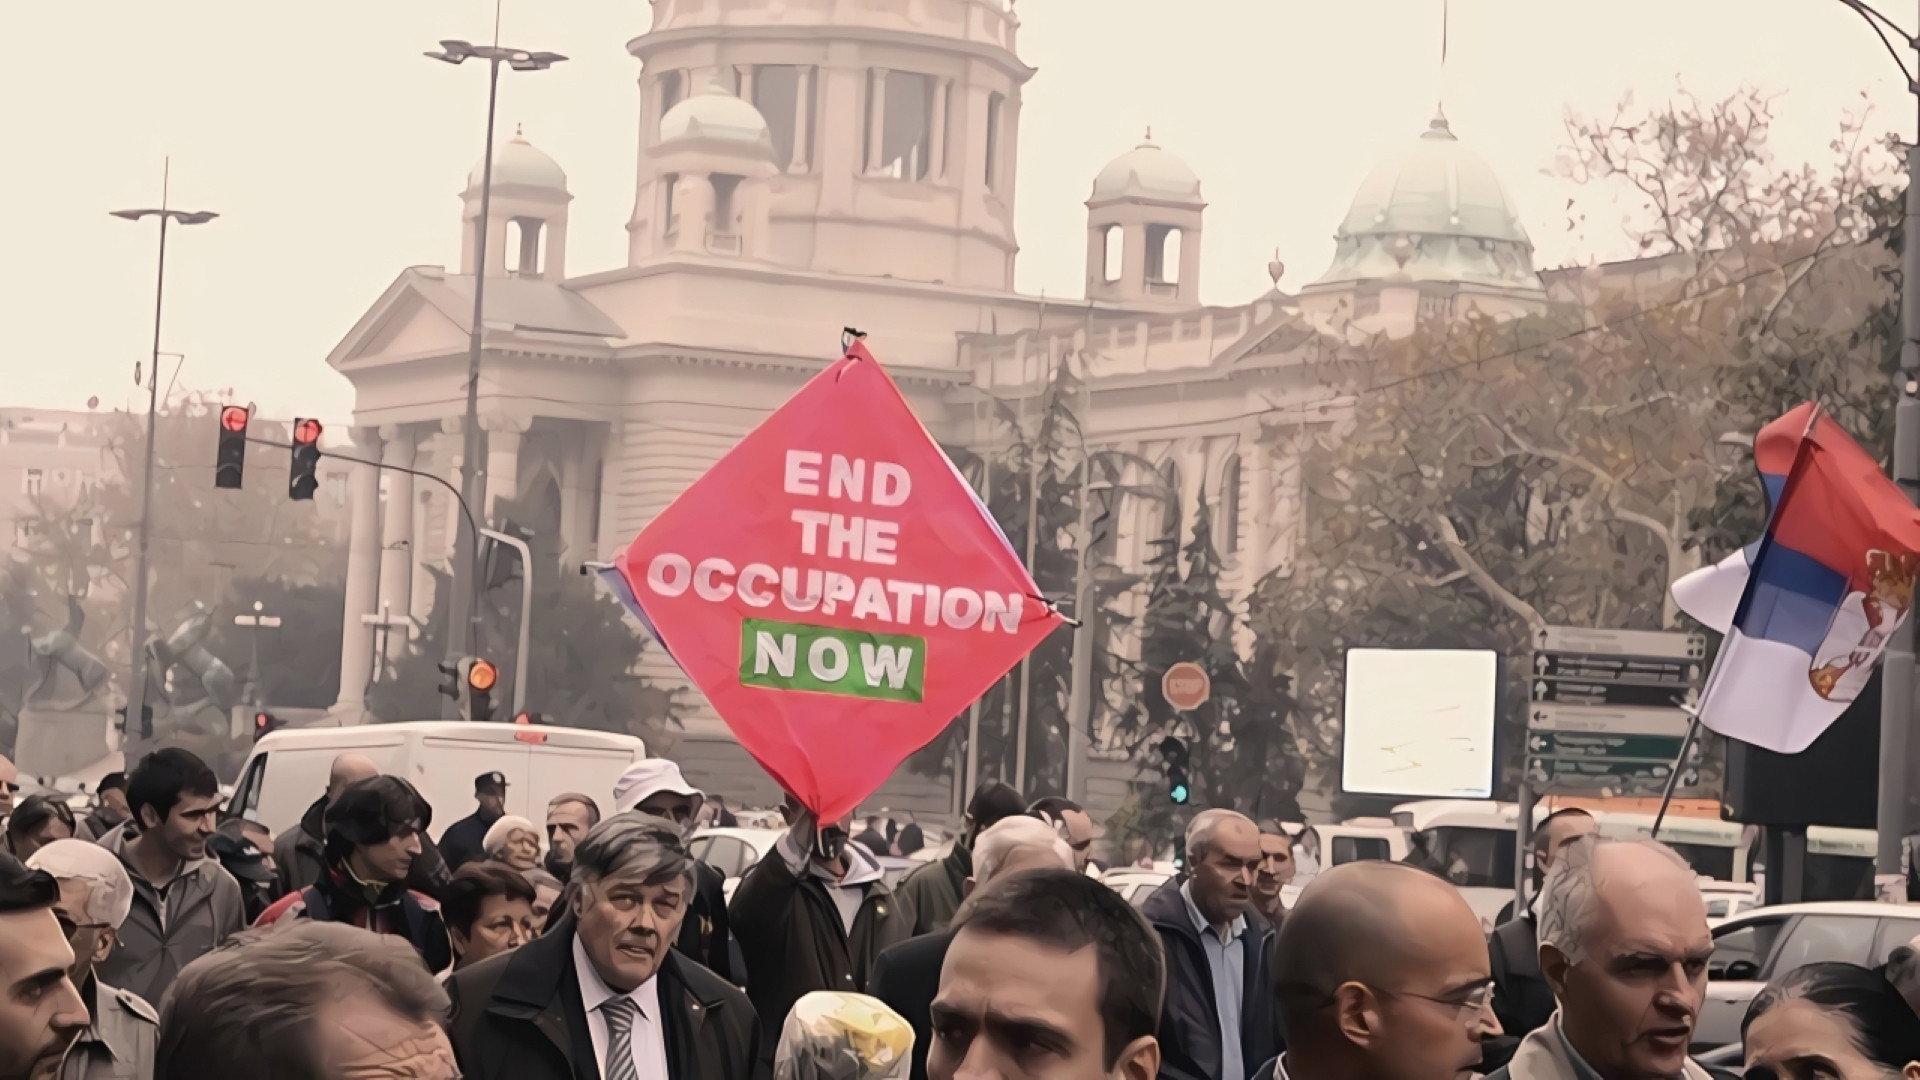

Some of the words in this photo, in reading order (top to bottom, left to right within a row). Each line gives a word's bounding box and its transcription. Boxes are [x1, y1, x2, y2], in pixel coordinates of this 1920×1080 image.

[784, 449, 912, 506] END
[791, 509, 899, 565] THE
[647, 553, 1023, 634] OCCUPATION
[754, 630, 913, 689] NOW
